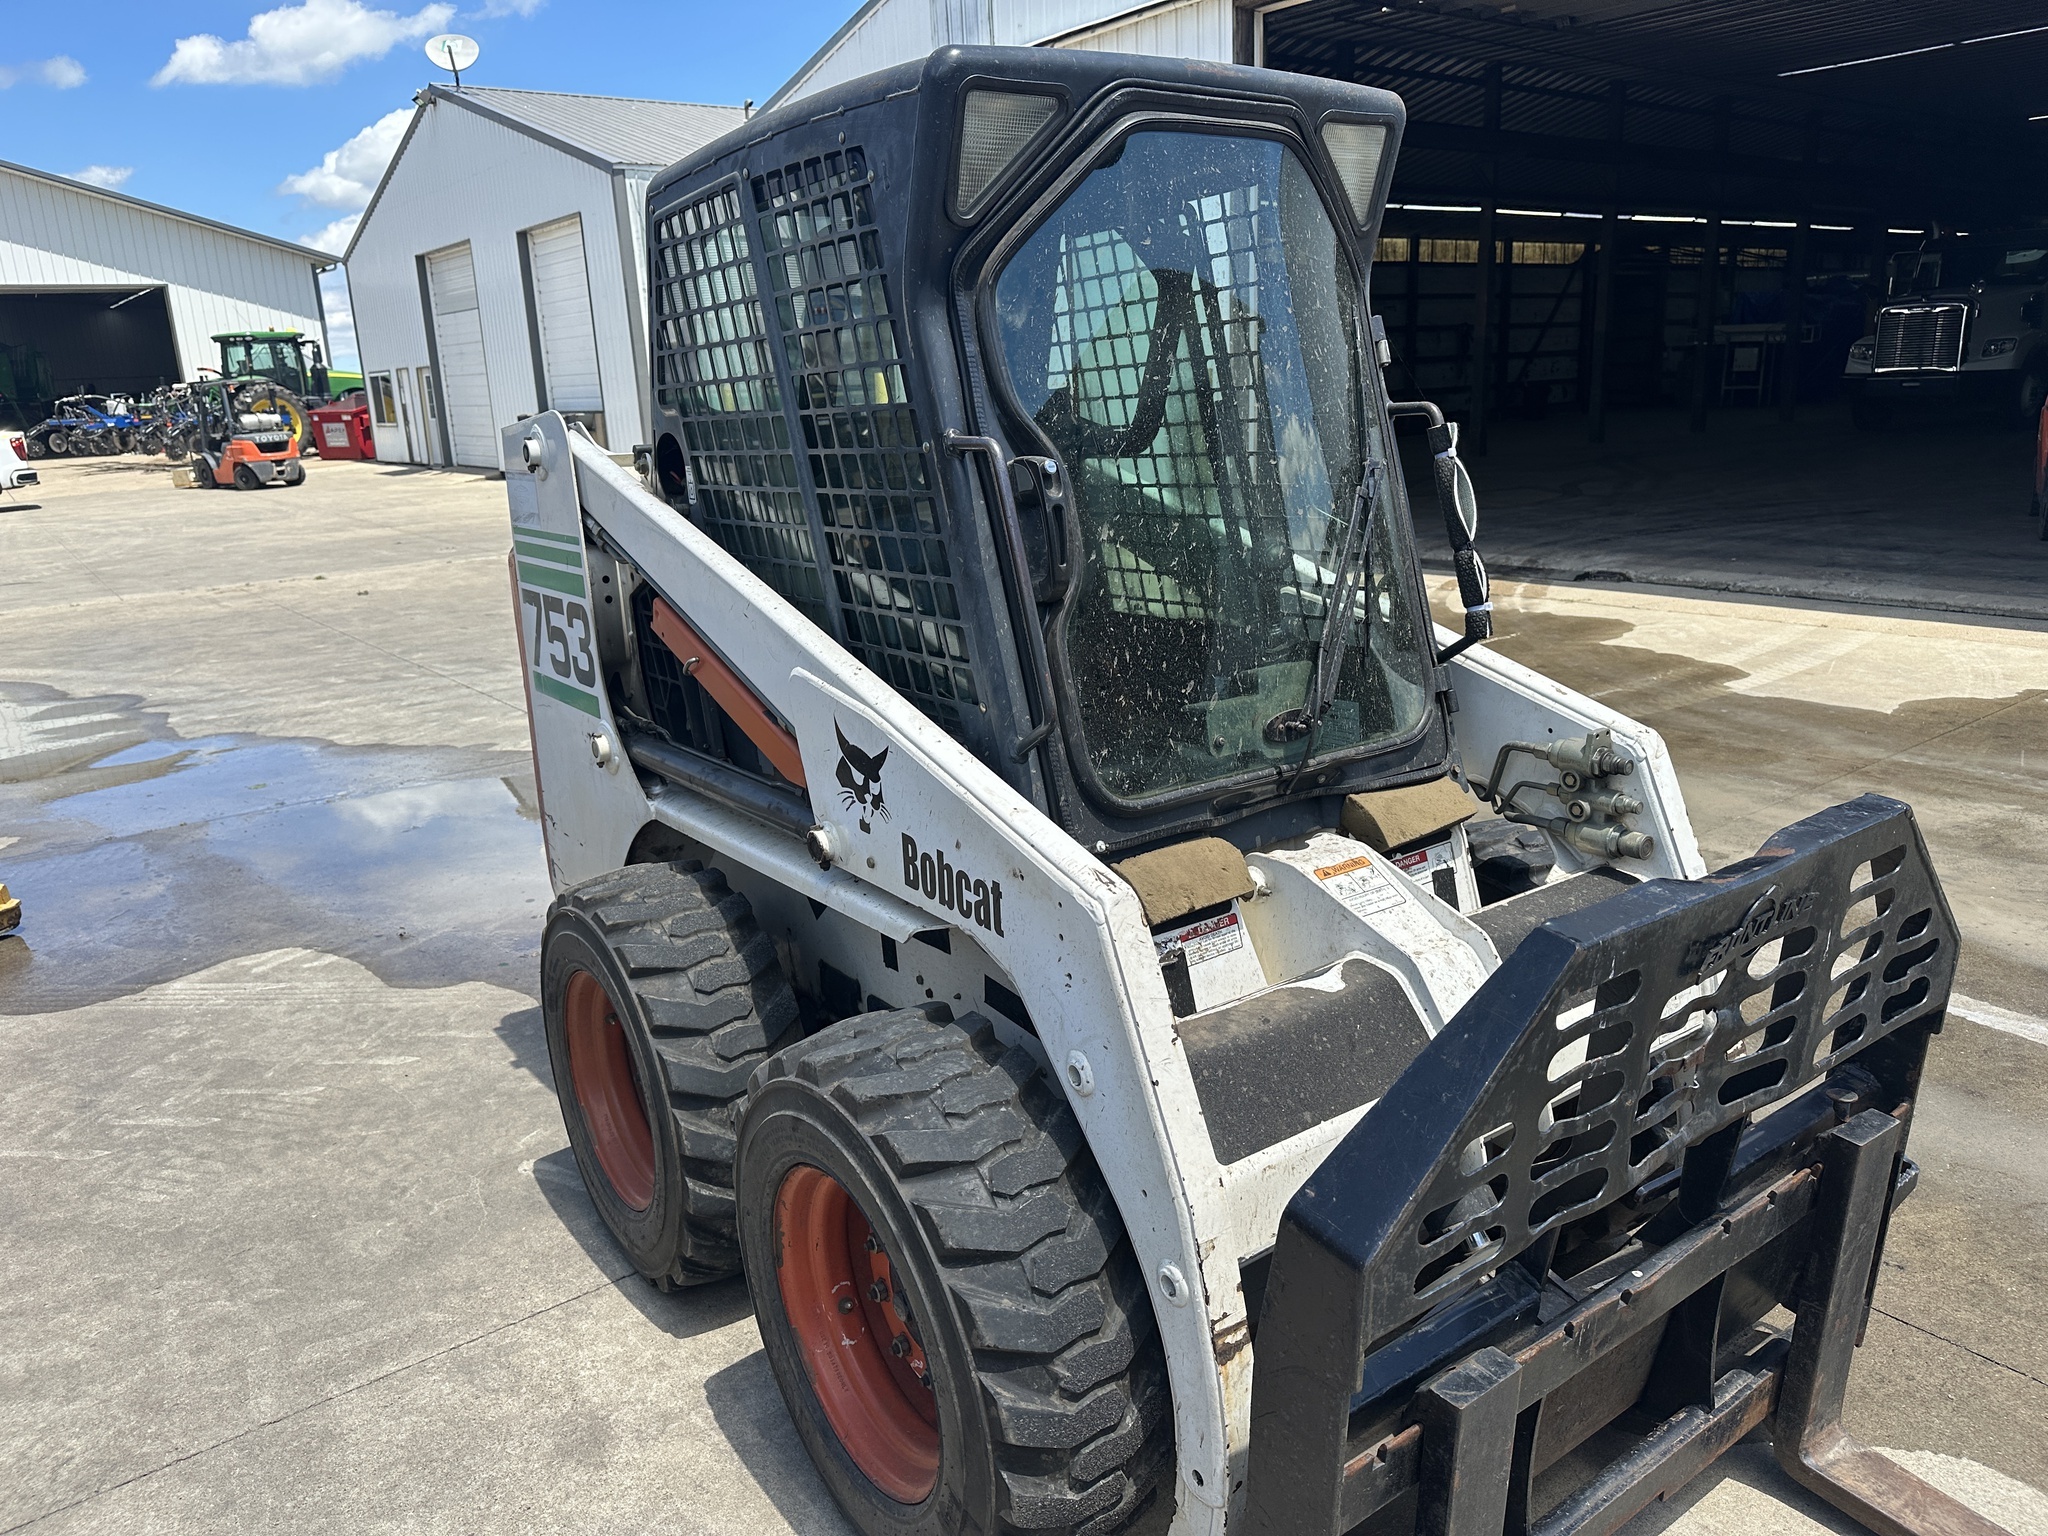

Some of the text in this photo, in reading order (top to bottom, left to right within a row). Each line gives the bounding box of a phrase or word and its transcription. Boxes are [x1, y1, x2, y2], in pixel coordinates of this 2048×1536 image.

[254, 434, 288, 442] TOYOTA
[521, 587, 596, 688] 753
[1331, 859, 1366, 873] WARNING
[1395, 854, 1421, 867] DANGER
[901, 832, 1005, 938] Bobcat
